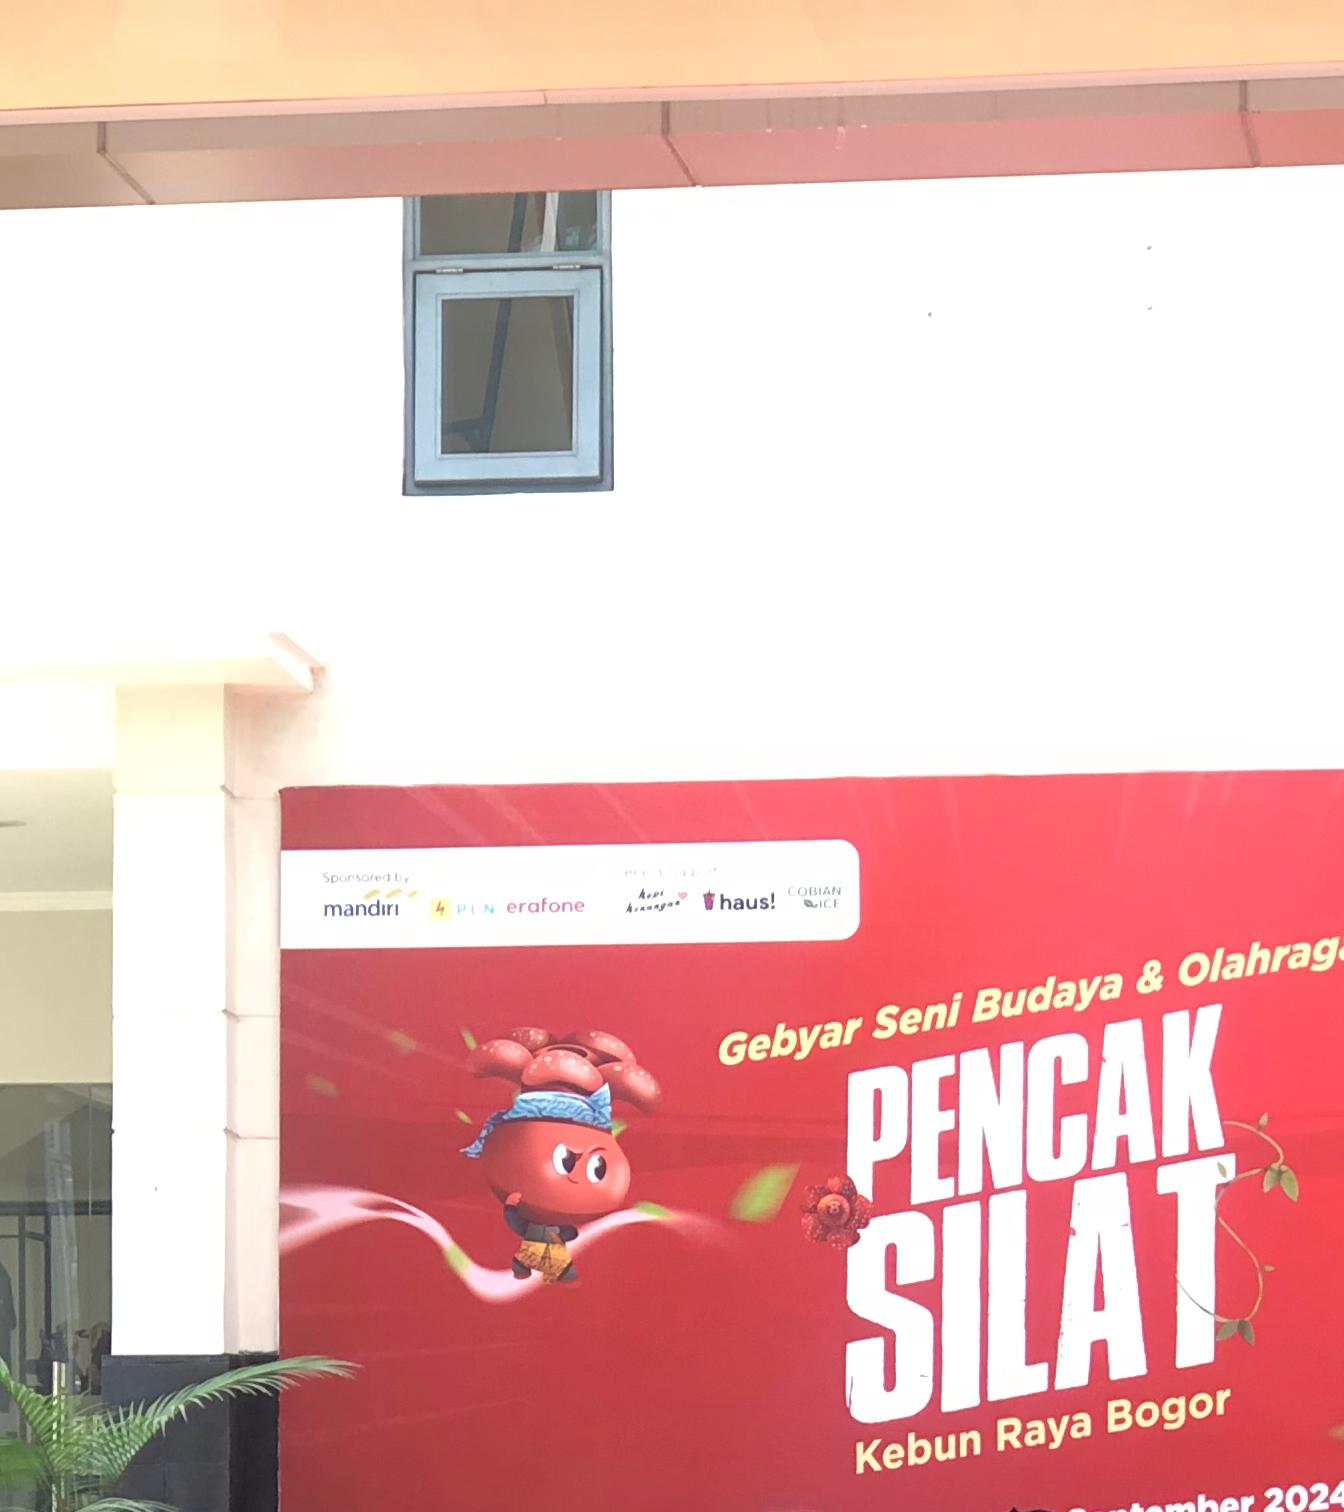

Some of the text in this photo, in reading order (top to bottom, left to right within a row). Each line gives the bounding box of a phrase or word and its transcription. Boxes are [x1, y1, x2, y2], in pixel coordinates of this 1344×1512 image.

[323, 899, 400, 918] mandiri
[457, 902, 495, 915] PLN
[506, 896, 585, 914] erafone
[720, 892, 776, 911] haus!
[718, 1018, 862, 1067] Gebyar
[871, 993, 960, 1041] Seni
[971, 972, 1124, 1024] Budaya
[1135, 959, 1164, 994] &
[846, 1003, 1226, 1206] PENCAK
[845, 1153, 1237, 1425] SILAT
[855, 1388, 1231, 1474] Kebun Raya Bogor
